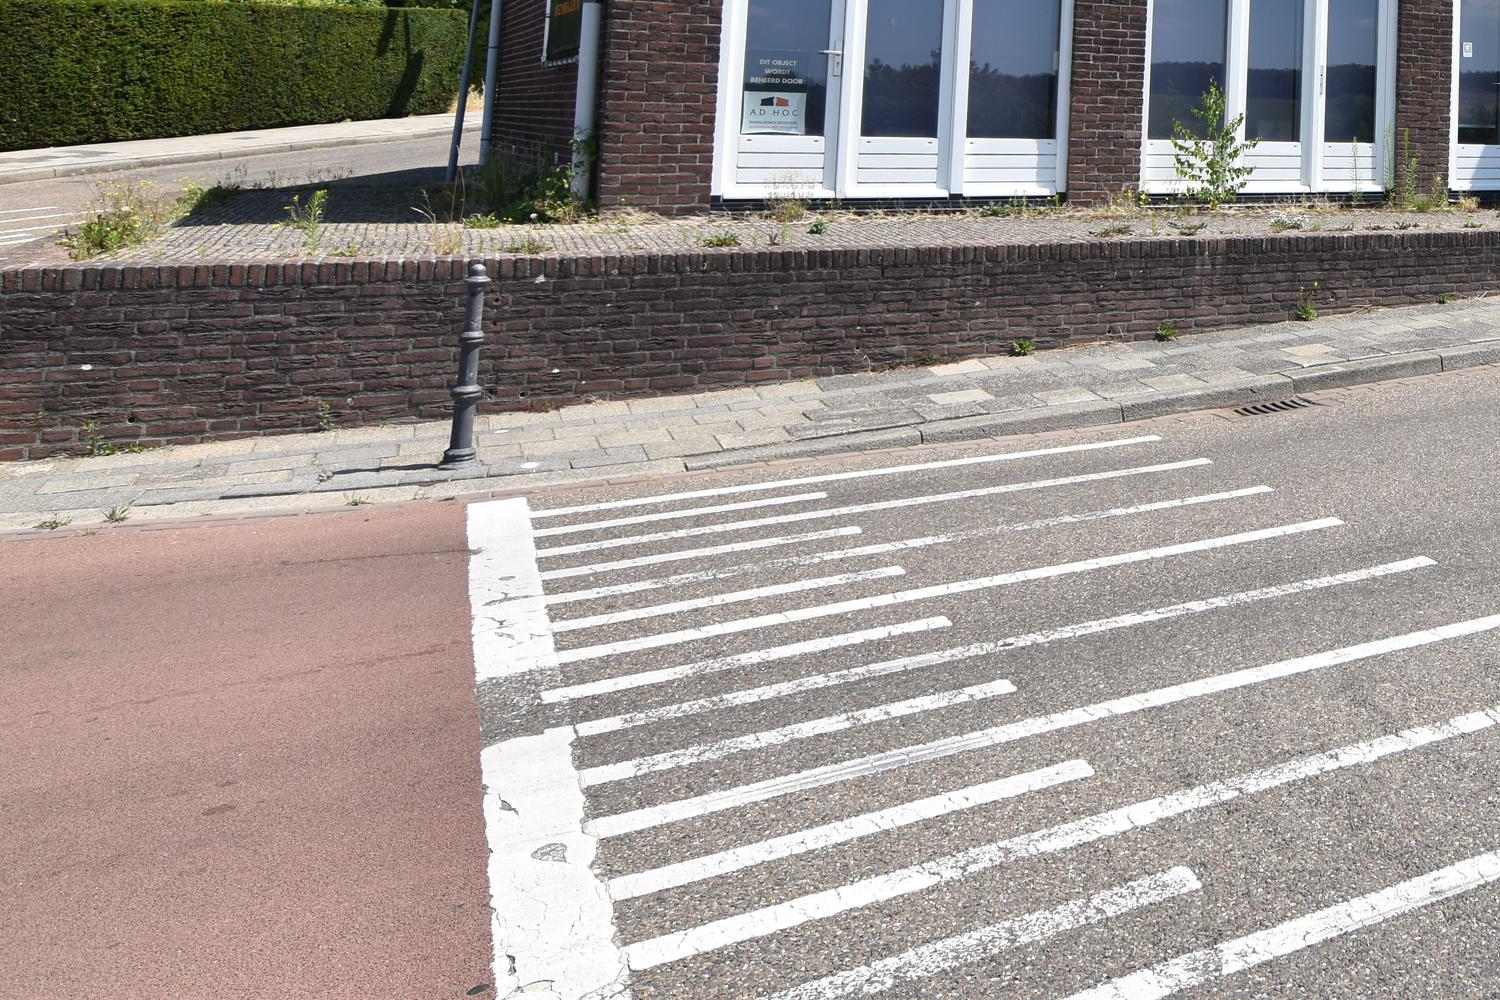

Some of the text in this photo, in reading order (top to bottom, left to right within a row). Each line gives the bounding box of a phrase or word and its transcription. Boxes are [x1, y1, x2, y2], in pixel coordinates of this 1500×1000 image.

[782, 77, 804, 85] DOOR
[750, 108, 799, 117] AD HOC
